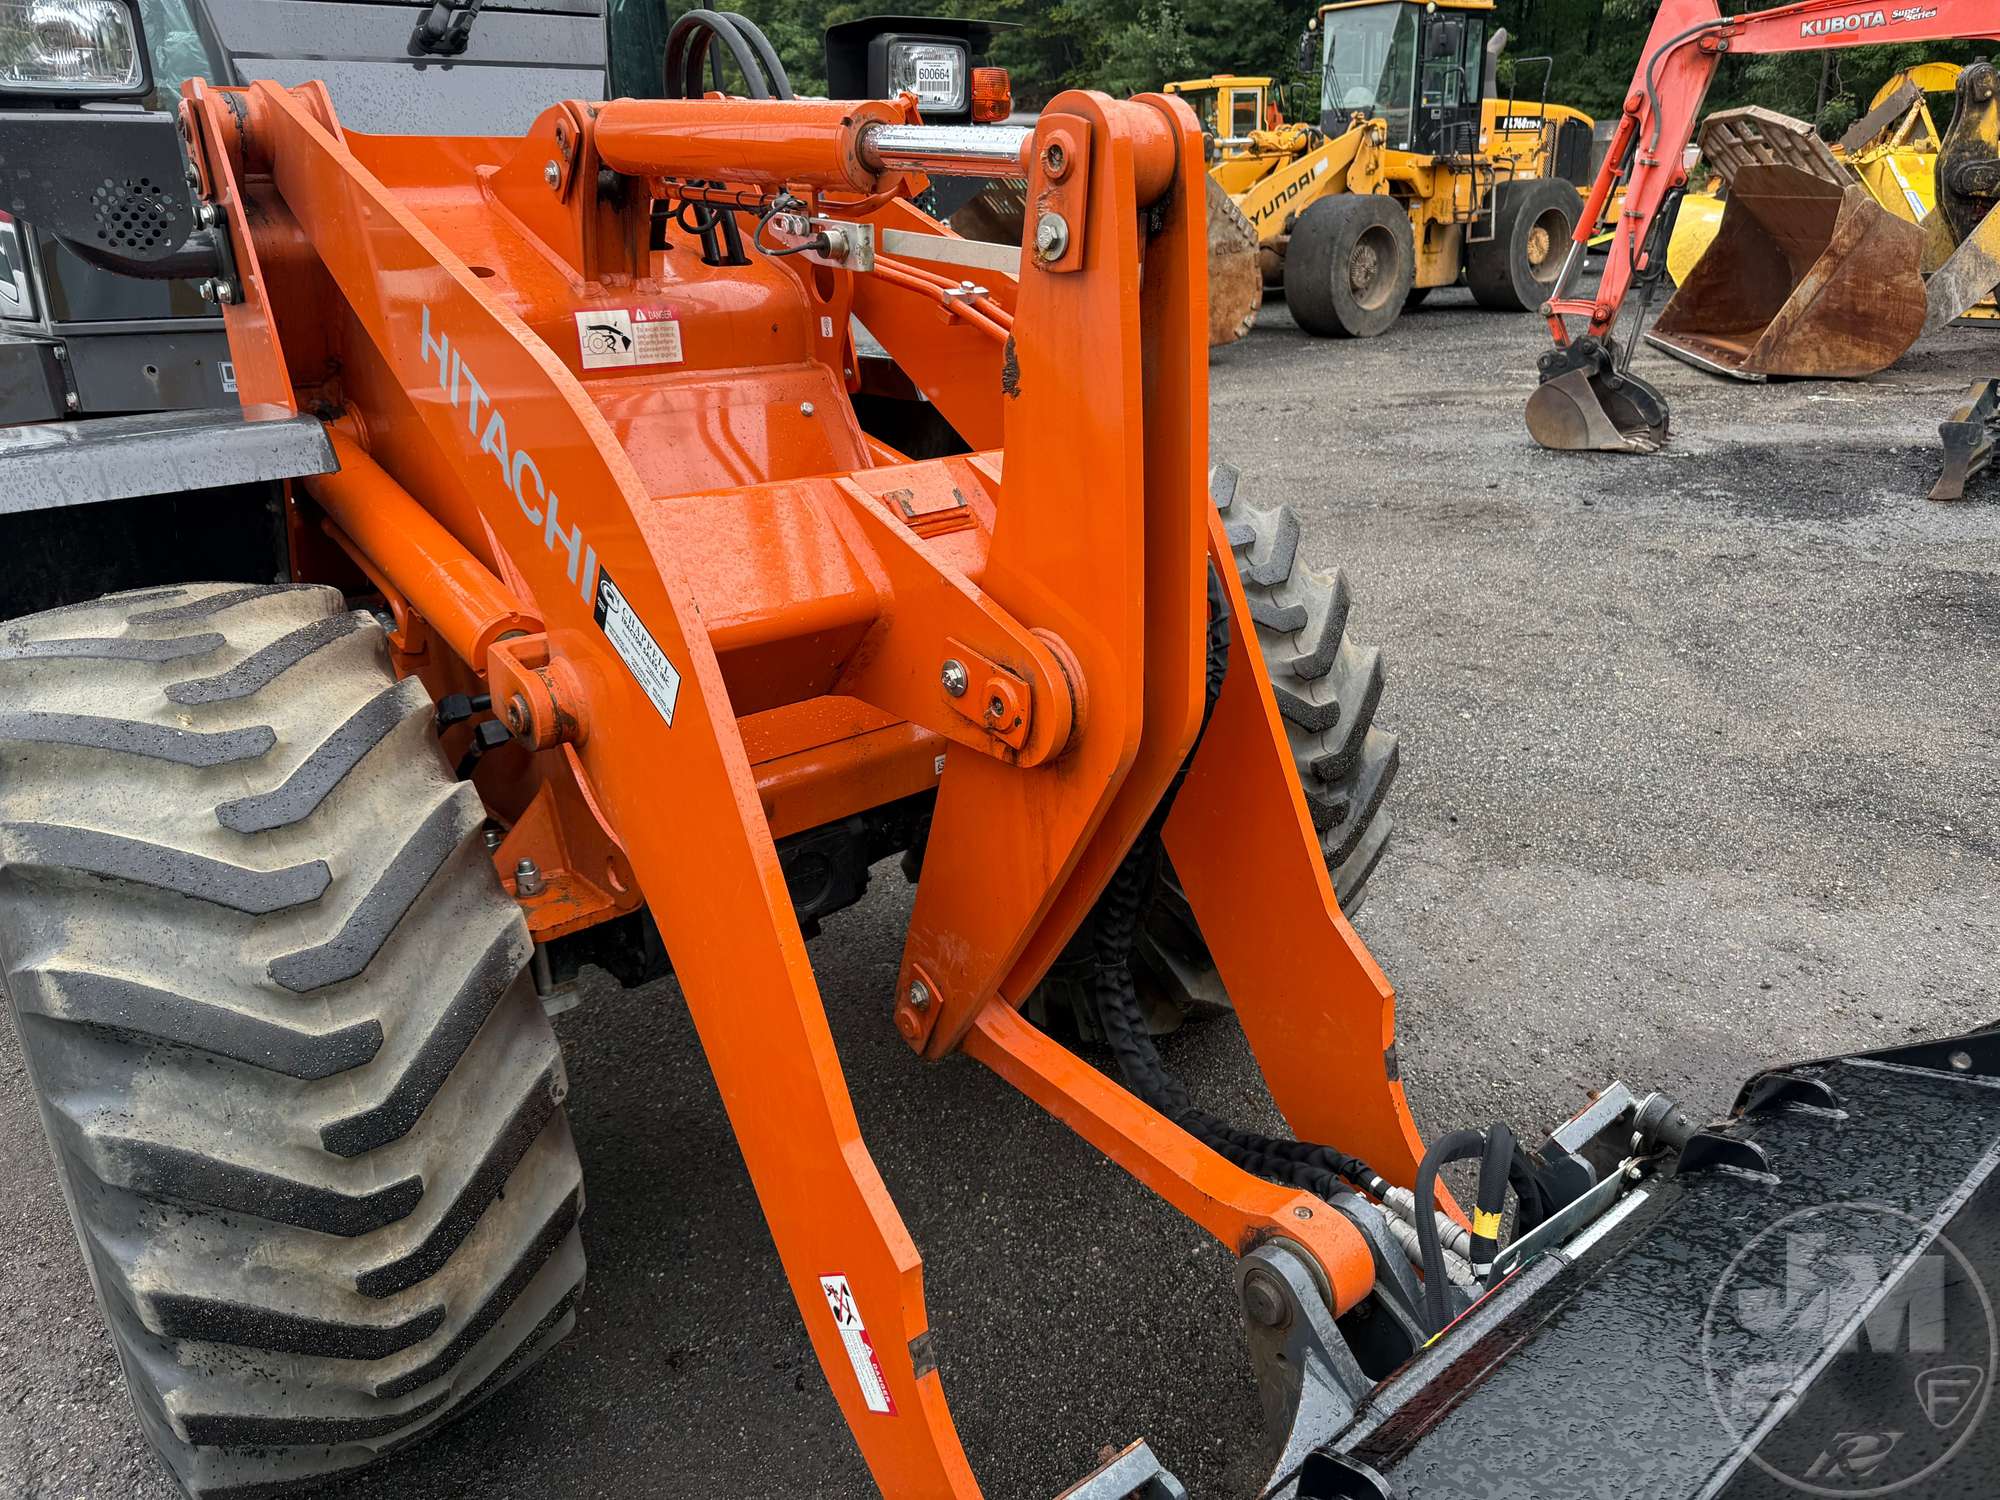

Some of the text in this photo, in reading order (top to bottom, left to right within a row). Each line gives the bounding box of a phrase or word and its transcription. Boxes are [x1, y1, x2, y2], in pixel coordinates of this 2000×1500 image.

[1800, 9, 1886, 38] KUBOTA
[1891, 6, 1922, 20] Super
[1905, 7, 1937, 21] Series
[919, 68, 949, 80] 600664
[1249, 168, 1316, 226] YUNDAI
[648, 310, 673, 320] DANGER
[420, 304, 597, 605] HITACHI
[621, 615, 642, 649] TRACTOR
[622, 604, 671, 679] CHAPPELL
[872, 1363, 890, 1403] DANGER
